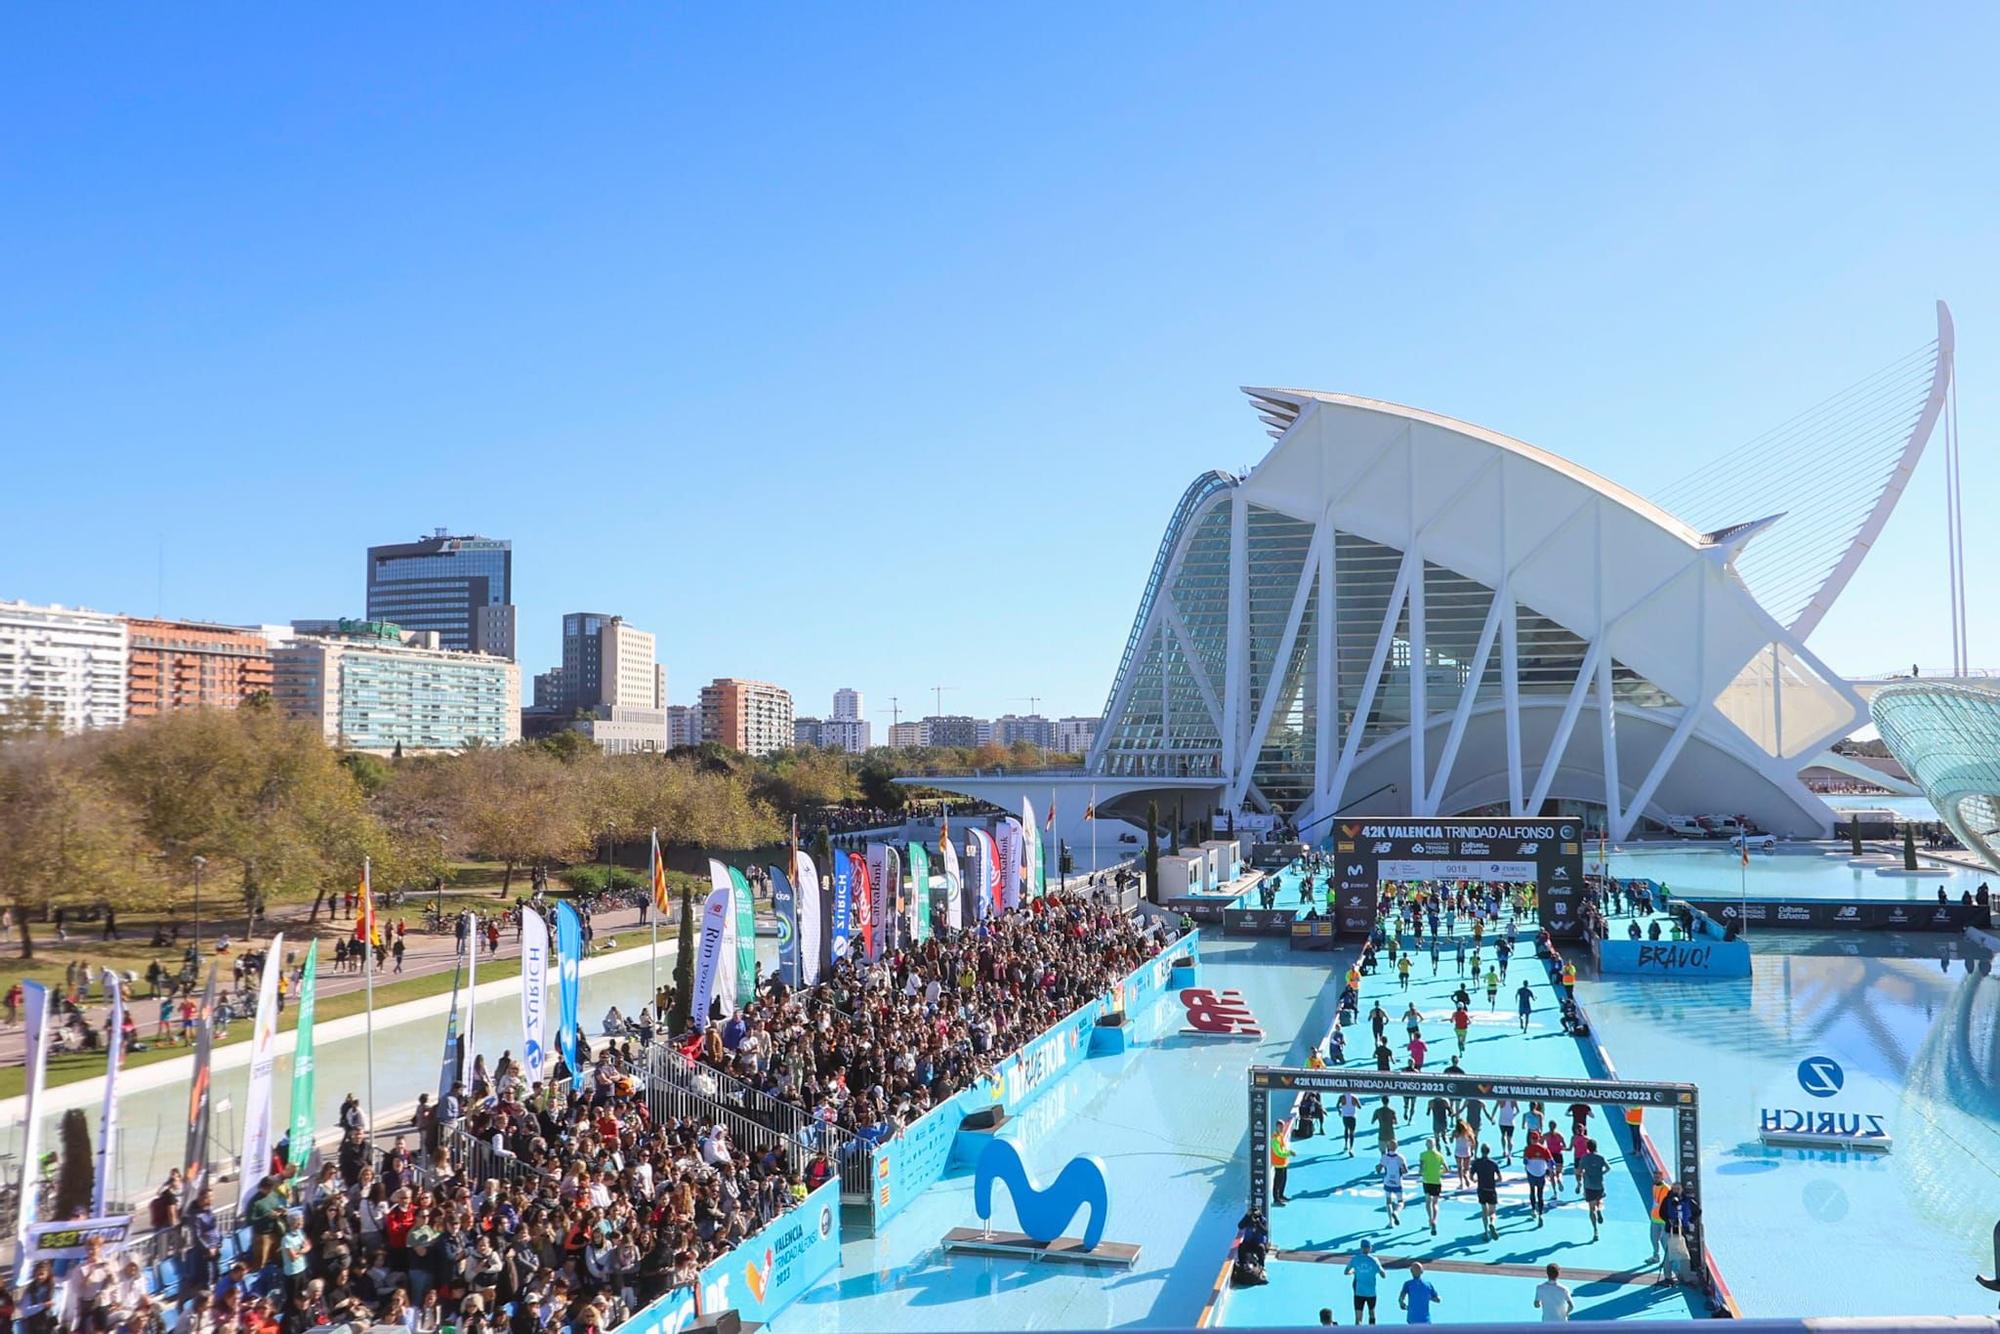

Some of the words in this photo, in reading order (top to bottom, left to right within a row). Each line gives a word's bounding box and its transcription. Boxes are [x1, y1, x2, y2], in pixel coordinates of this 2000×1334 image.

[1361, 826, 1386, 838] 42K
[1387, 826, 1442, 838] VALENCIA
[1444, 826, 1497, 839] TRINIDAD
[1498, 826, 1555, 839] ALFONSO
[1446, 865, 1467, 873] 9018
[872, 860, 882, 928] CaixaBank
[704, 927, 720, 958] Run
[1638, 945, 1711, 969] BRAVO!
[1294, 1078, 1310, 1086] 42K
[1311, 1078, 1348, 1088] VALENCIA
[1349, 1079, 1383, 1089] TRINIDAD
[1384, 1081, 1420, 1090] ALFONSO
[1421, 1083, 1444, 1091] 2023
[1492, 1086, 1509, 1094] 42K
[1510, 1087, 1548, 1096] VALENCIA
[1550, 1088, 1586, 1098] TRINIDAD
[1586, 1089, 1625, 1099] ALFONSO
[1627, 1091, 1650, 1100] 2023
[773, 1224, 803, 1254] VALENCIA
